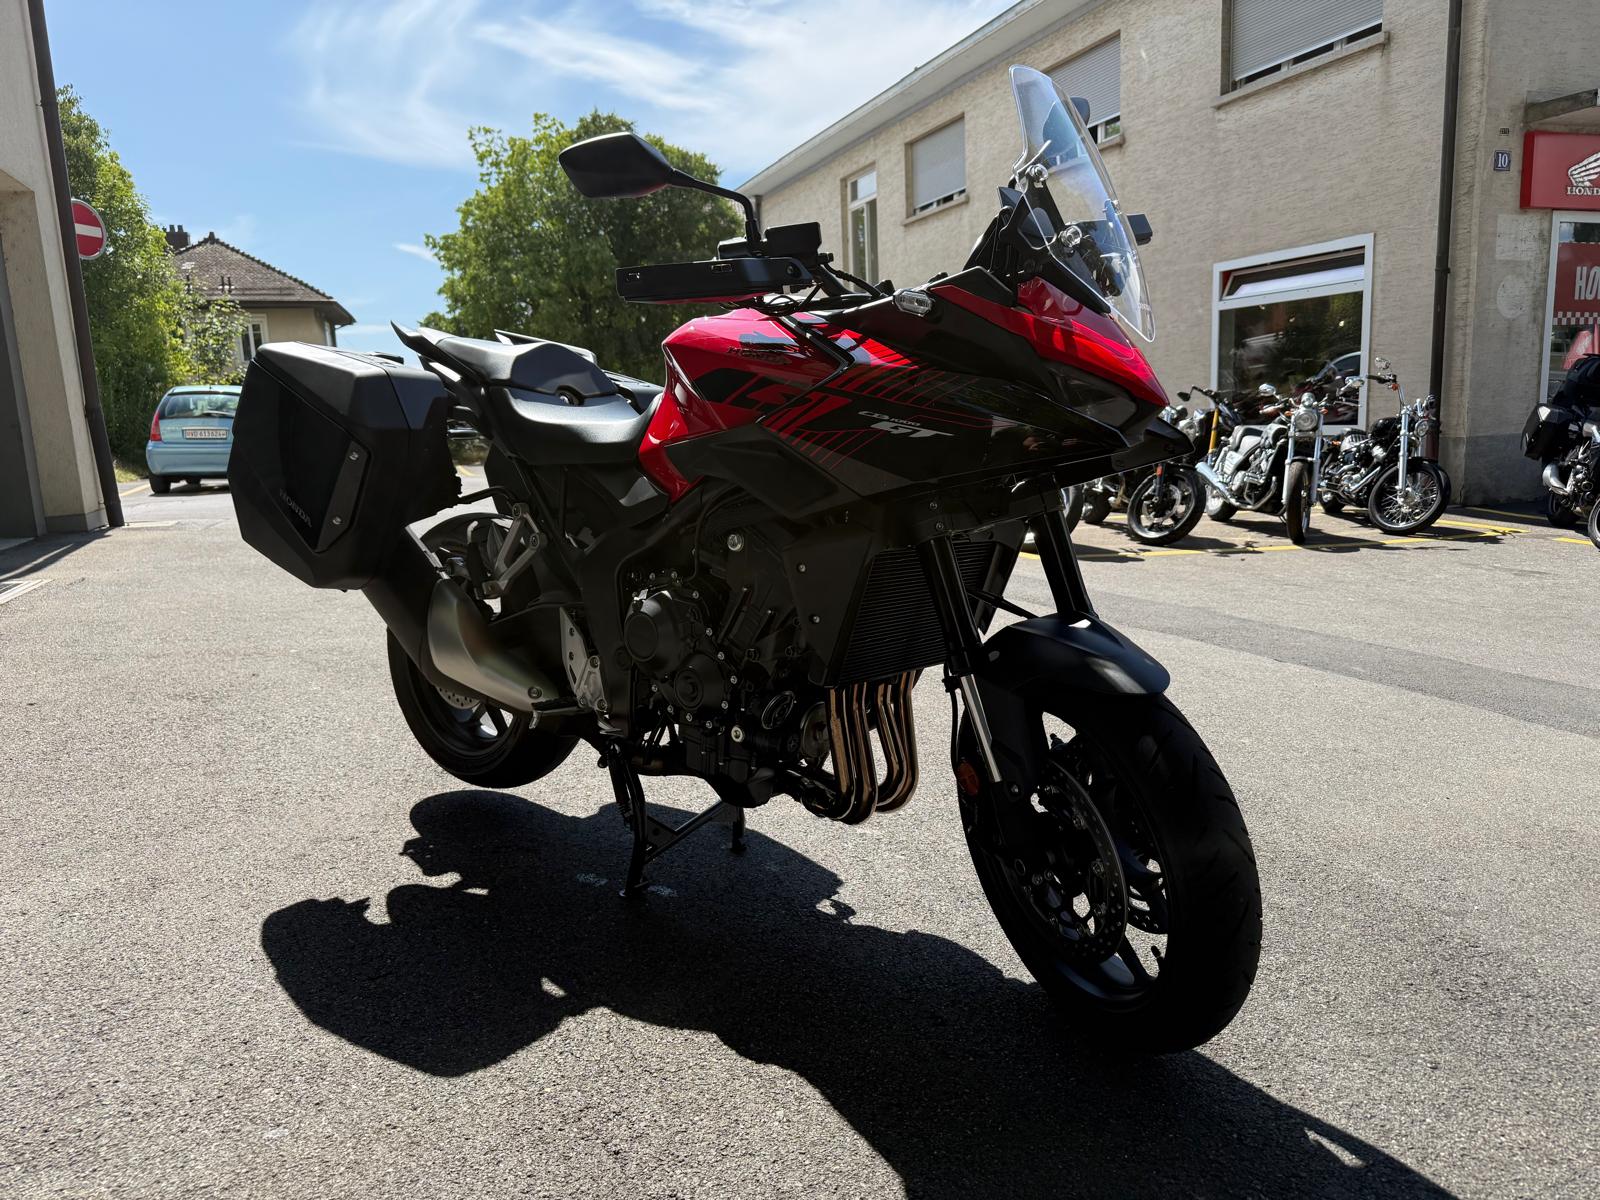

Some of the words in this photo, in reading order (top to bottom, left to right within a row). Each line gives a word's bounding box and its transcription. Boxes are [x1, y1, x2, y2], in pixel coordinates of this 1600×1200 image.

[1497, 153, 1509, 168] 10
[1574, 265, 1600, 300] HO
[727, 346, 792, 365] HONDA
[869, 421, 955, 438] GT
[279, 487, 313, 528] HONDA
